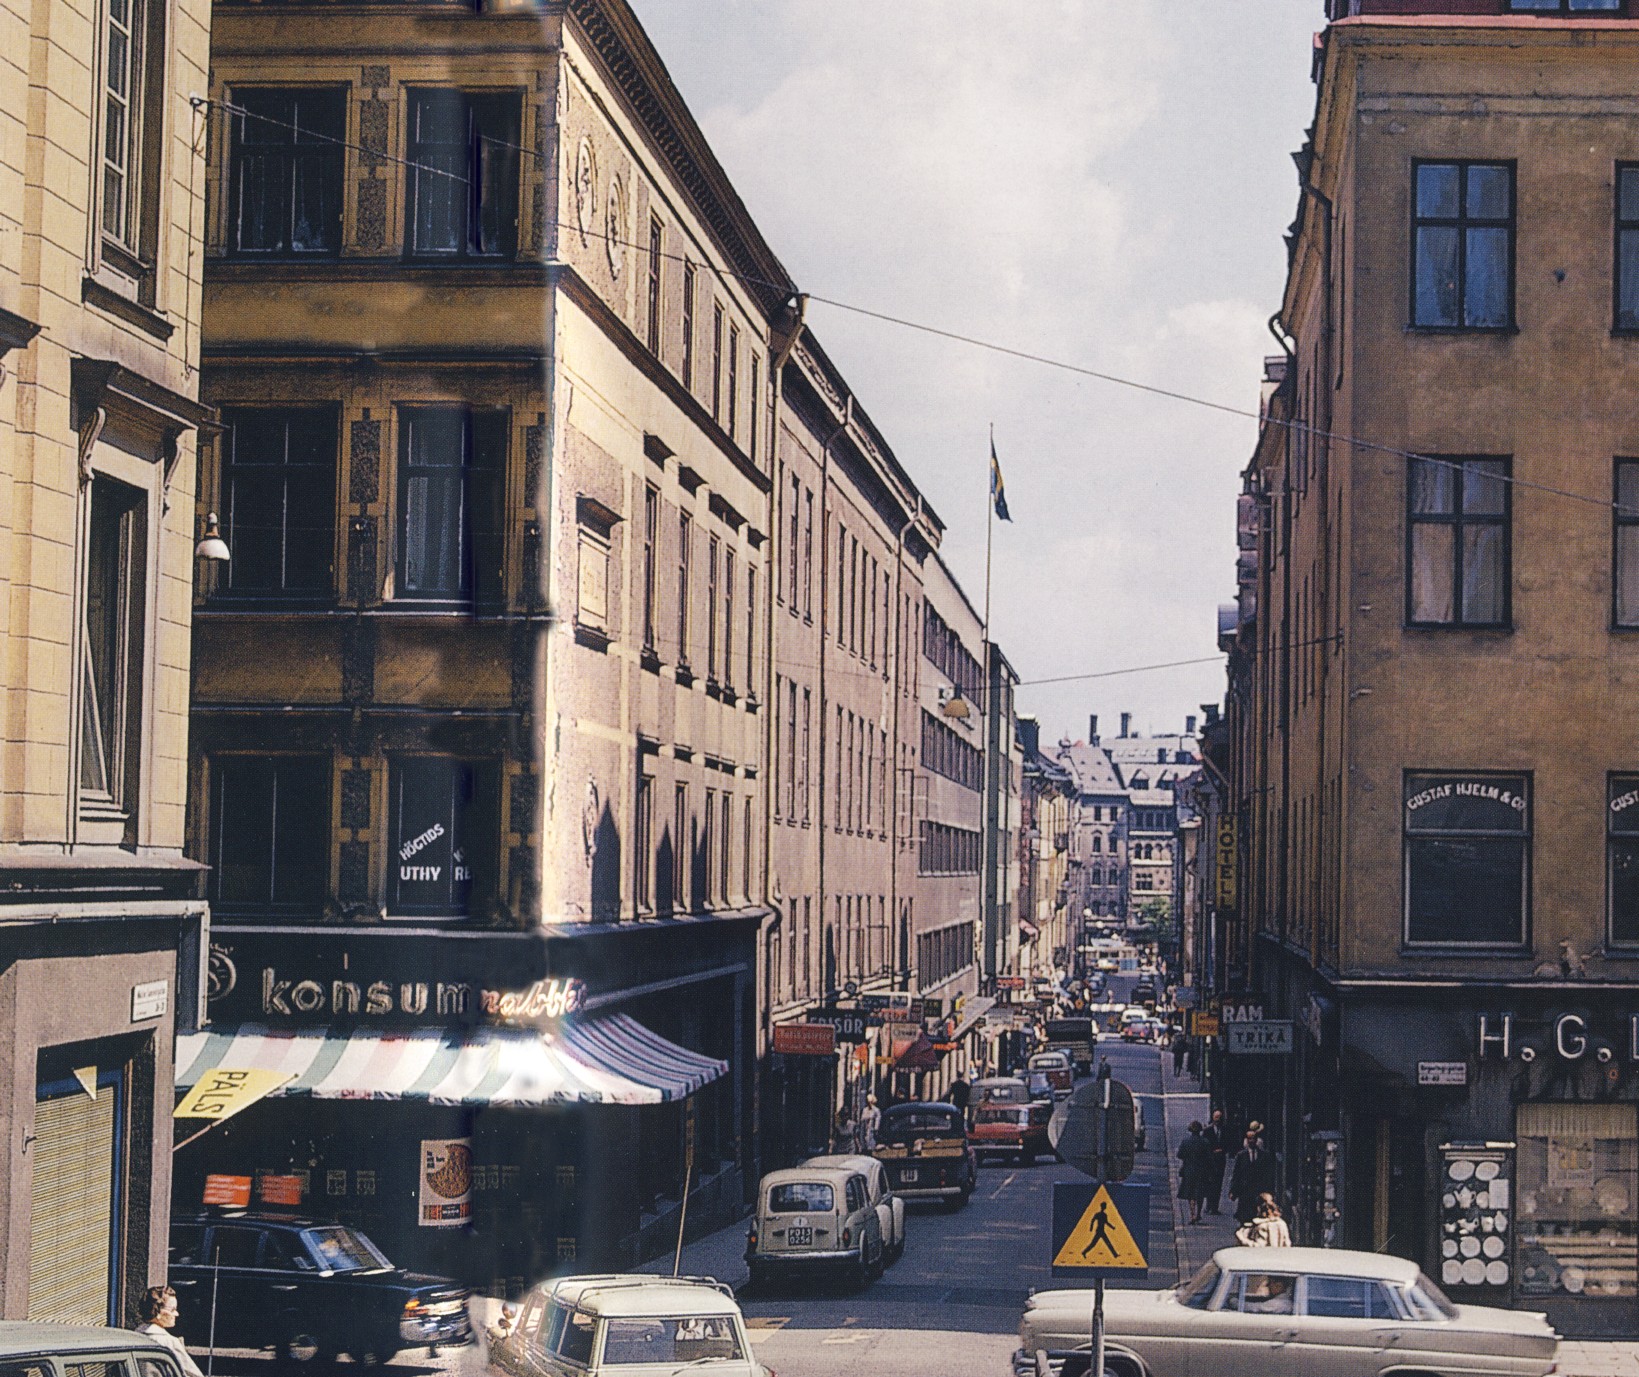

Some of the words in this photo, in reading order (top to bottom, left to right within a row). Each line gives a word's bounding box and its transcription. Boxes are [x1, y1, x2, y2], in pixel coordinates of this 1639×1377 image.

[1406, 784, 1452, 810] GUSTAF
[1456, 783, 1500, 799] HJELM
[1500, 791, 1511, 804] &
[400, 866, 441, 881] UTHY
[1219, 814, 1234, 910] HOTELL
[262, 966, 471, 1015] konsum
[1222, 1005, 1262, 1023] RAM
[191, 1071, 249, 1113] PÄLS
